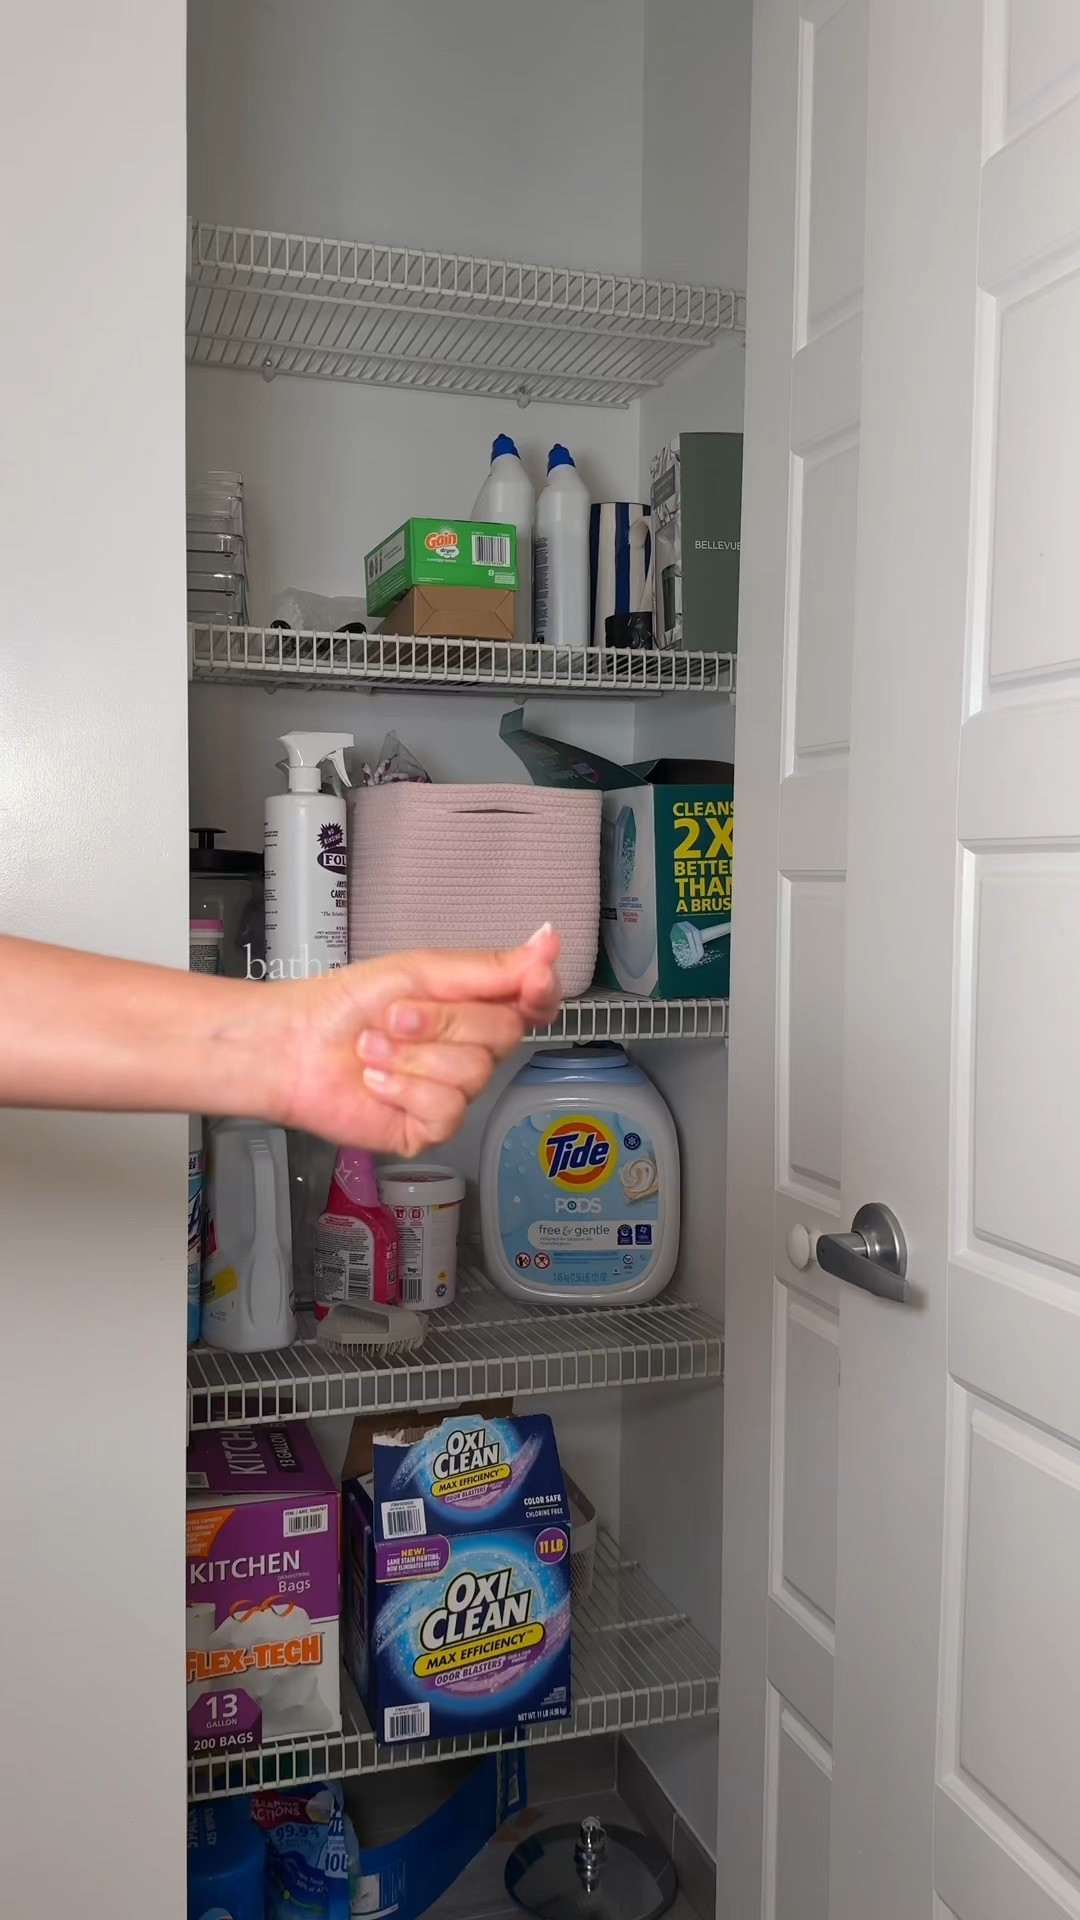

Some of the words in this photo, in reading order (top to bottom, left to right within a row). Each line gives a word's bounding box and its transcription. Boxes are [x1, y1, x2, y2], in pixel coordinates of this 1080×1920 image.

[425, 532, 458, 550] Gain
[673, 817, 734, 859] 2X
[674, 860, 733, 876] BETTE
[675, 899, 688, 912] A
[546, 1131, 610, 1179] Tide
[555, 1198, 602, 1214] PODS
[538, 1225, 560, 1236] free
[562, 1226, 573, 1236] &
[574, 1225, 610, 1237] gentle
[447, 1428, 485, 1456] OXI
[434, 1443, 500, 1480] CLEAN
[438, 1479, 457, 1493] MAX
[459, 1469, 500, 1486] EFFICIENCY
[523, 1496, 544, 1506] COLOR
[545, 1494, 562, 1503] SAFE
[525, 1509, 550, 1519] CHLORINE
[550, 1507, 564, 1515] FREE
[401, 1547, 426, 1557] NEW!
[538, 1540, 550, 1554] 11
[550, 1538, 564, 1553] LB
[189, 1550, 301, 1585] KITCHEN
[278, 1579, 312, 1594] Bags
[445, 1568, 512, 1613] OXI
[420, 1589, 532, 1651] CLEAN
[426, 1652, 457, 1670] MAX
[460, 1631, 526, 1661] EFFICIENCY
[436, 1671, 460, 1685] ODOR
[462, 1658, 503, 1678] BLASTERS
[205, 1693, 239, 1720] 13
[206, 1717, 239, 1729] GALLON
[518, 1712, 527, 1721] NET
[192, 1737, 216, 1752] 200
[219, 1731, 254, 1748] BAGS
[276, 1824, 320, 1841] 99.9%
